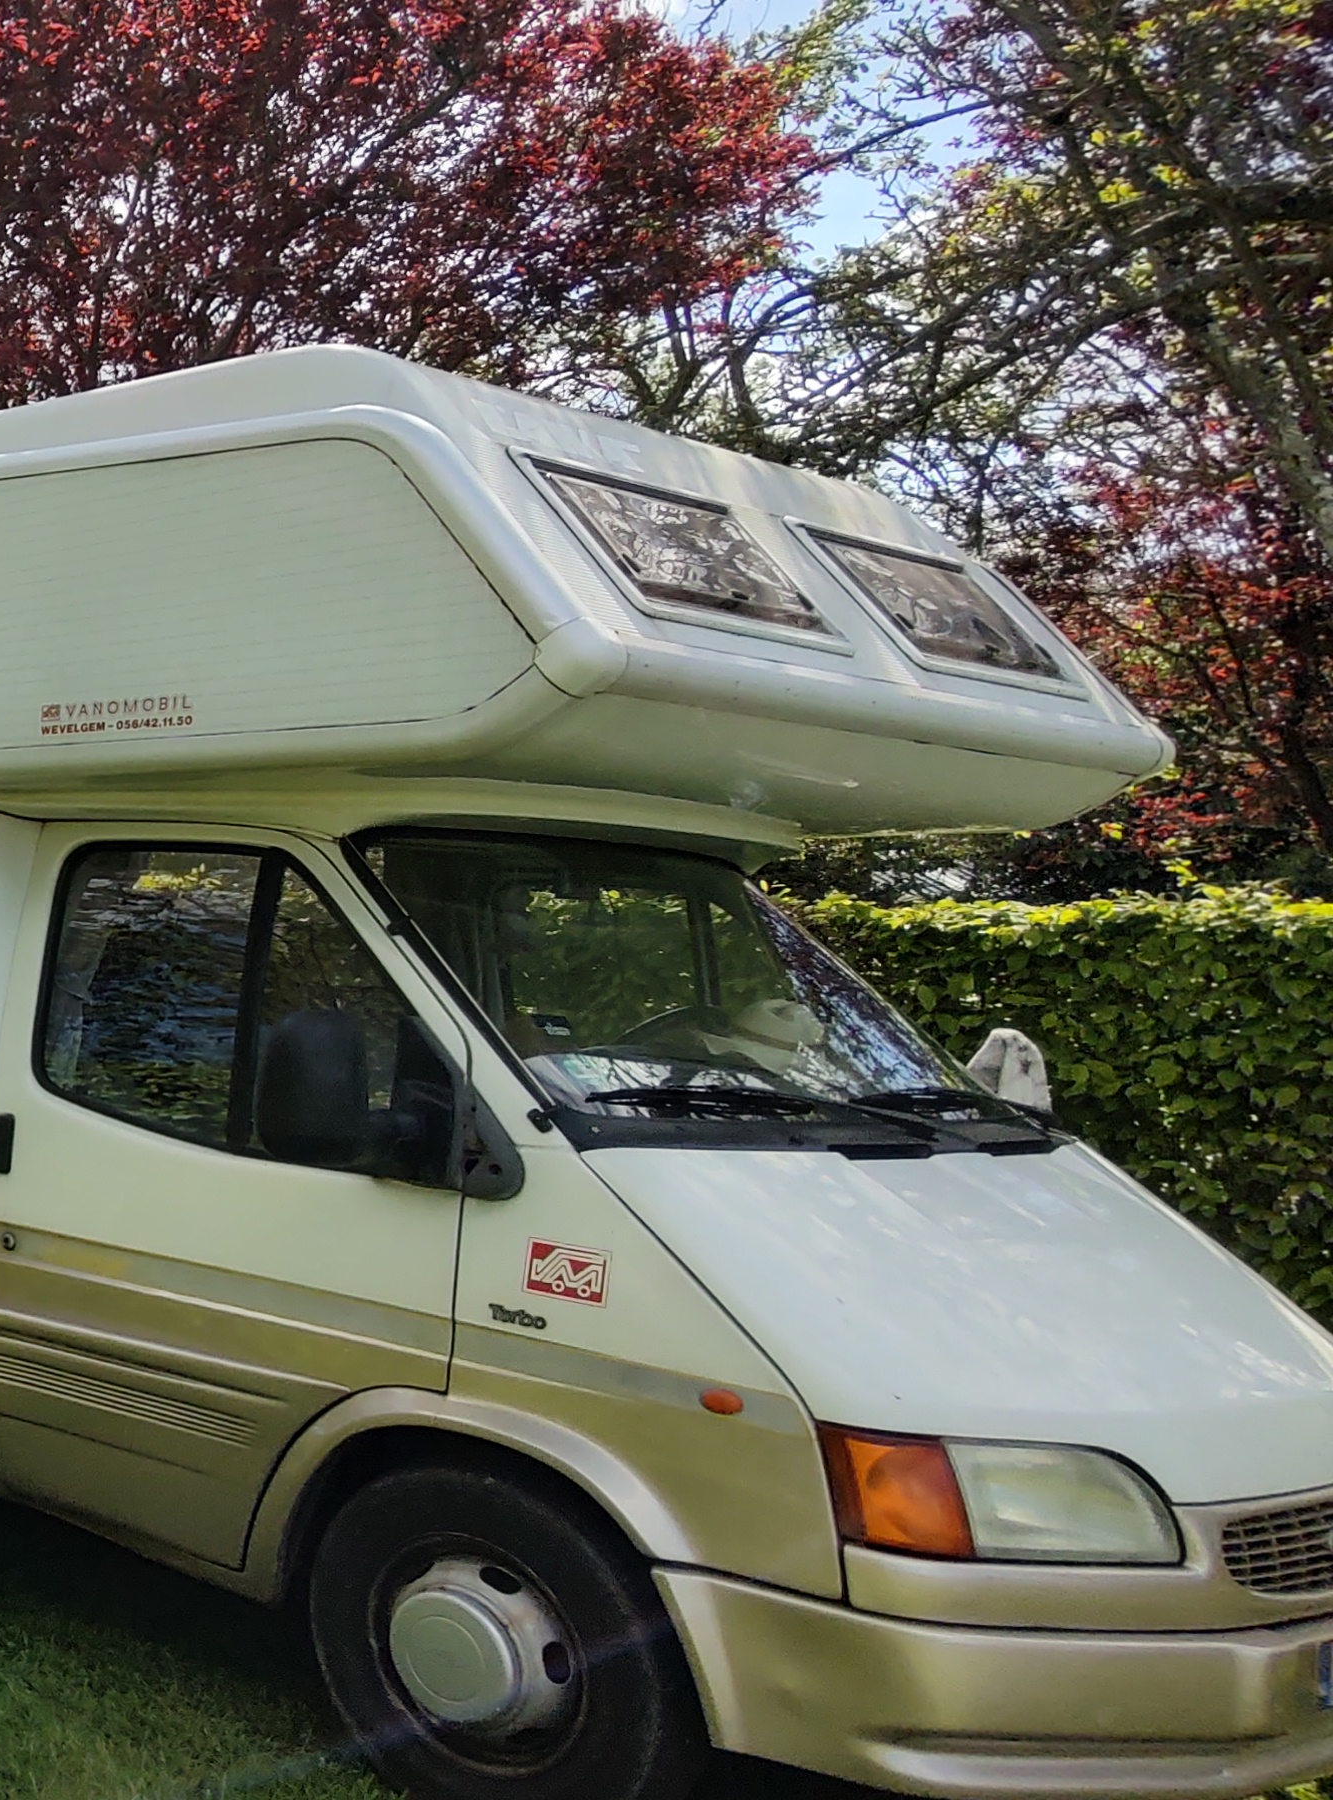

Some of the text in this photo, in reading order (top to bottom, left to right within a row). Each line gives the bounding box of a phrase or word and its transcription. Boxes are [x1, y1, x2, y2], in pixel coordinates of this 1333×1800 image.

[65, 694, 192, 717] VANOMOBIL
[41, 721, 105, 735] WEVELGEM
[116, 715, 193, 730] 056/42.11.50
[488, 1303, 547, 1330] Turbo
